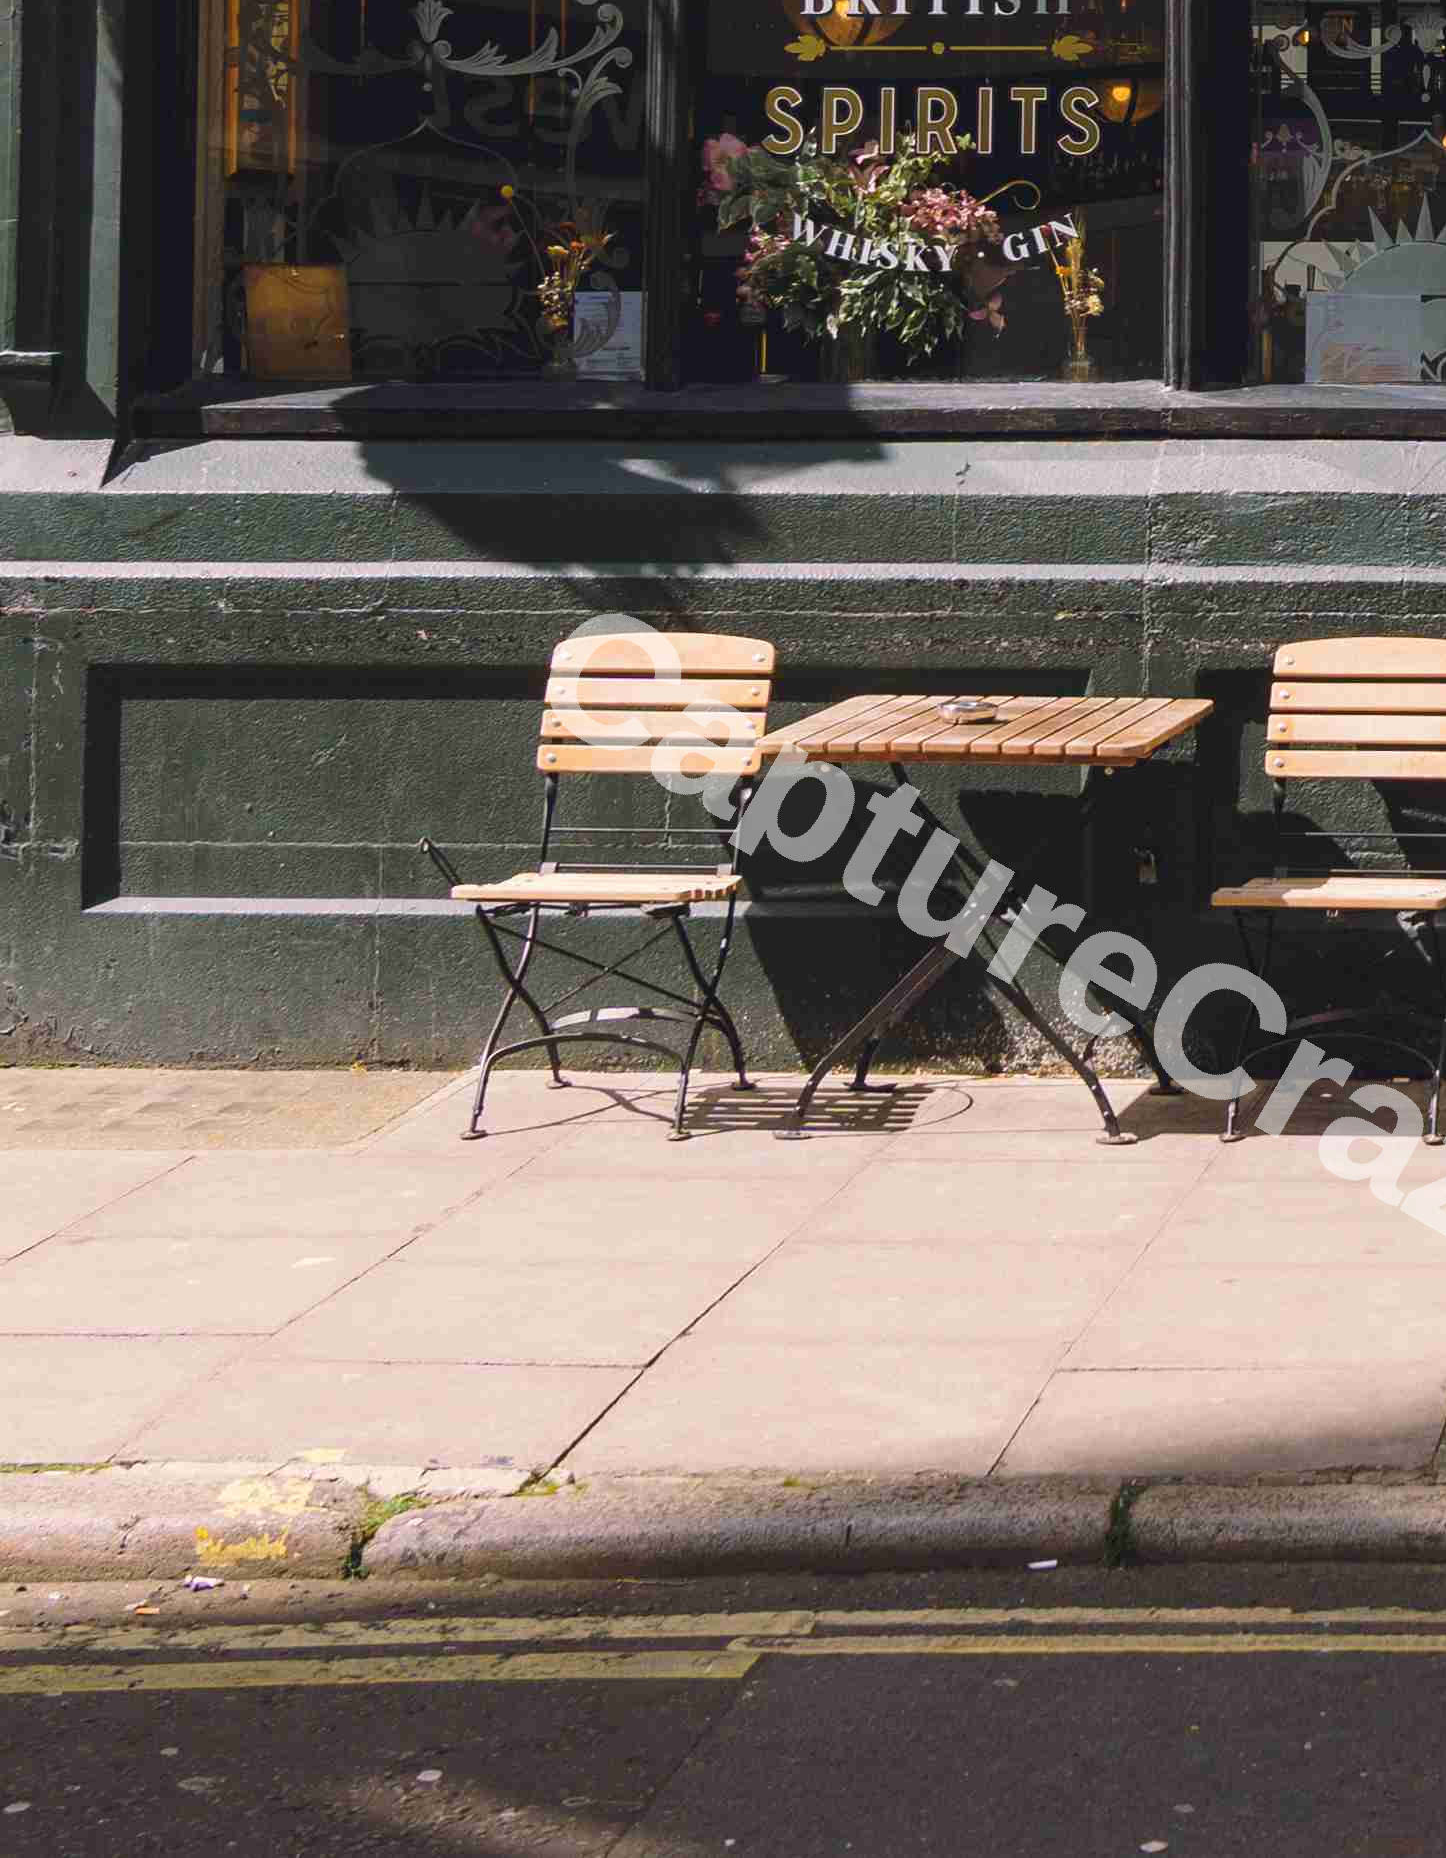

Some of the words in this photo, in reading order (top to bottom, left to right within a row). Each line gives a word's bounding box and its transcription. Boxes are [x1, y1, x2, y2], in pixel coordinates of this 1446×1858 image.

[761, 86, 1101, 156] SPIRITS
[791, 213, 959, 272] WHISKY
[1002, 213, 1081, 263] GIN
